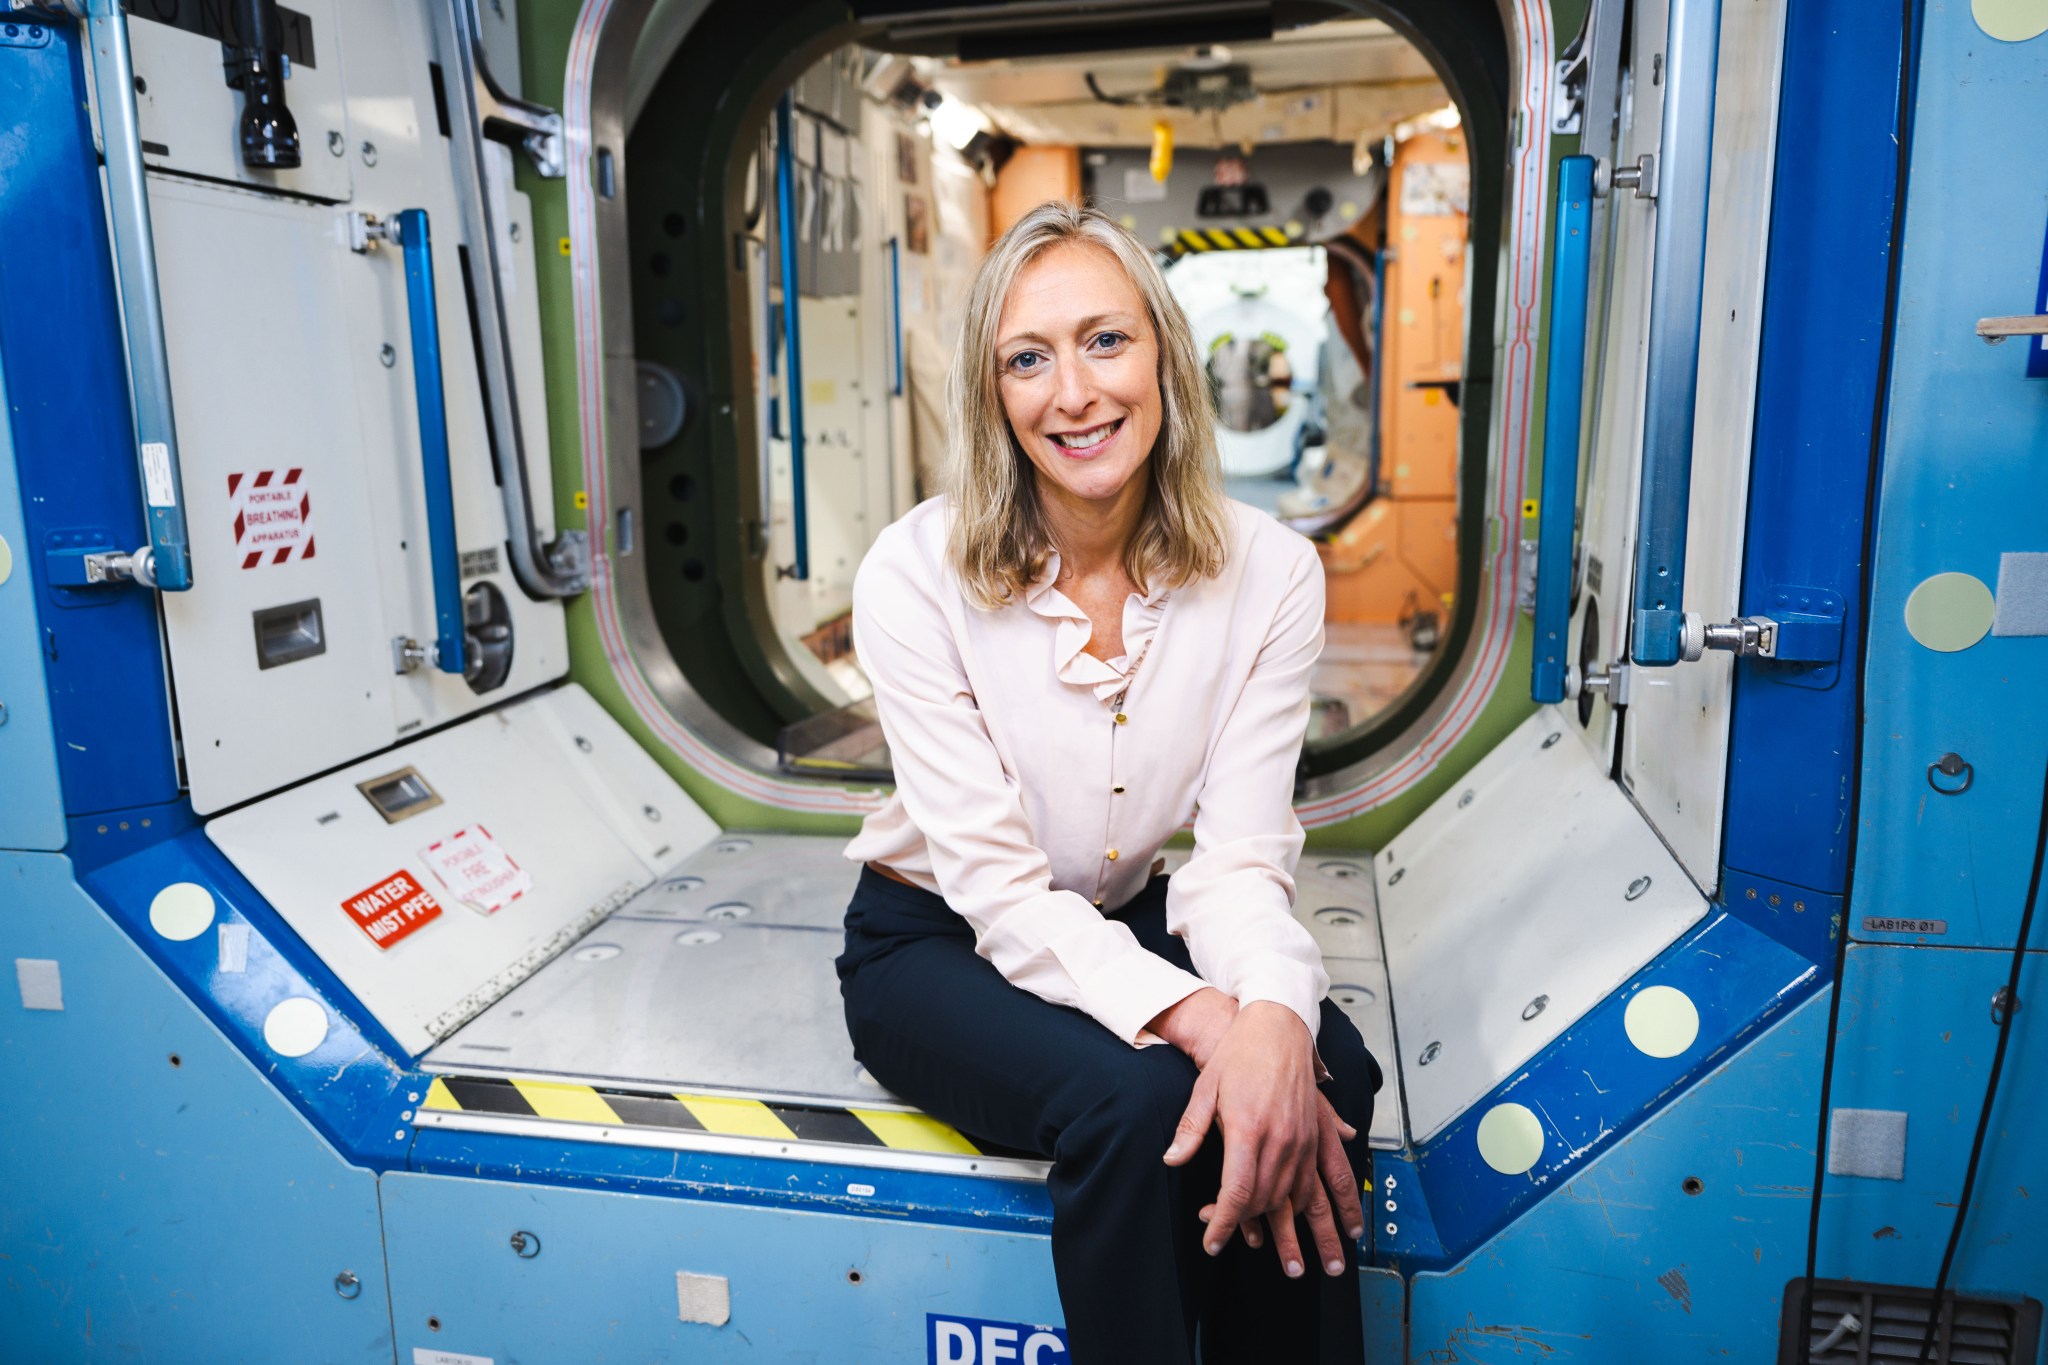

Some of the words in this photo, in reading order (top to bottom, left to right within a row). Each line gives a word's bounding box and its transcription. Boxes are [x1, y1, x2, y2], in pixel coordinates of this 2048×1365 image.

[248, 491, 291, 504] PORTABLE
[246, 508, 299, 526] BREATHING
[252, 529, 299, 543] APPARATUS
[462, 860, 491, 880] FIRE
[352, 876, 414, 918] WATER
[365, 909, 406, 941] MIST
[401, 891, 438, 921] PFE
[1871, 919, 1916, 931] LAB1P6
